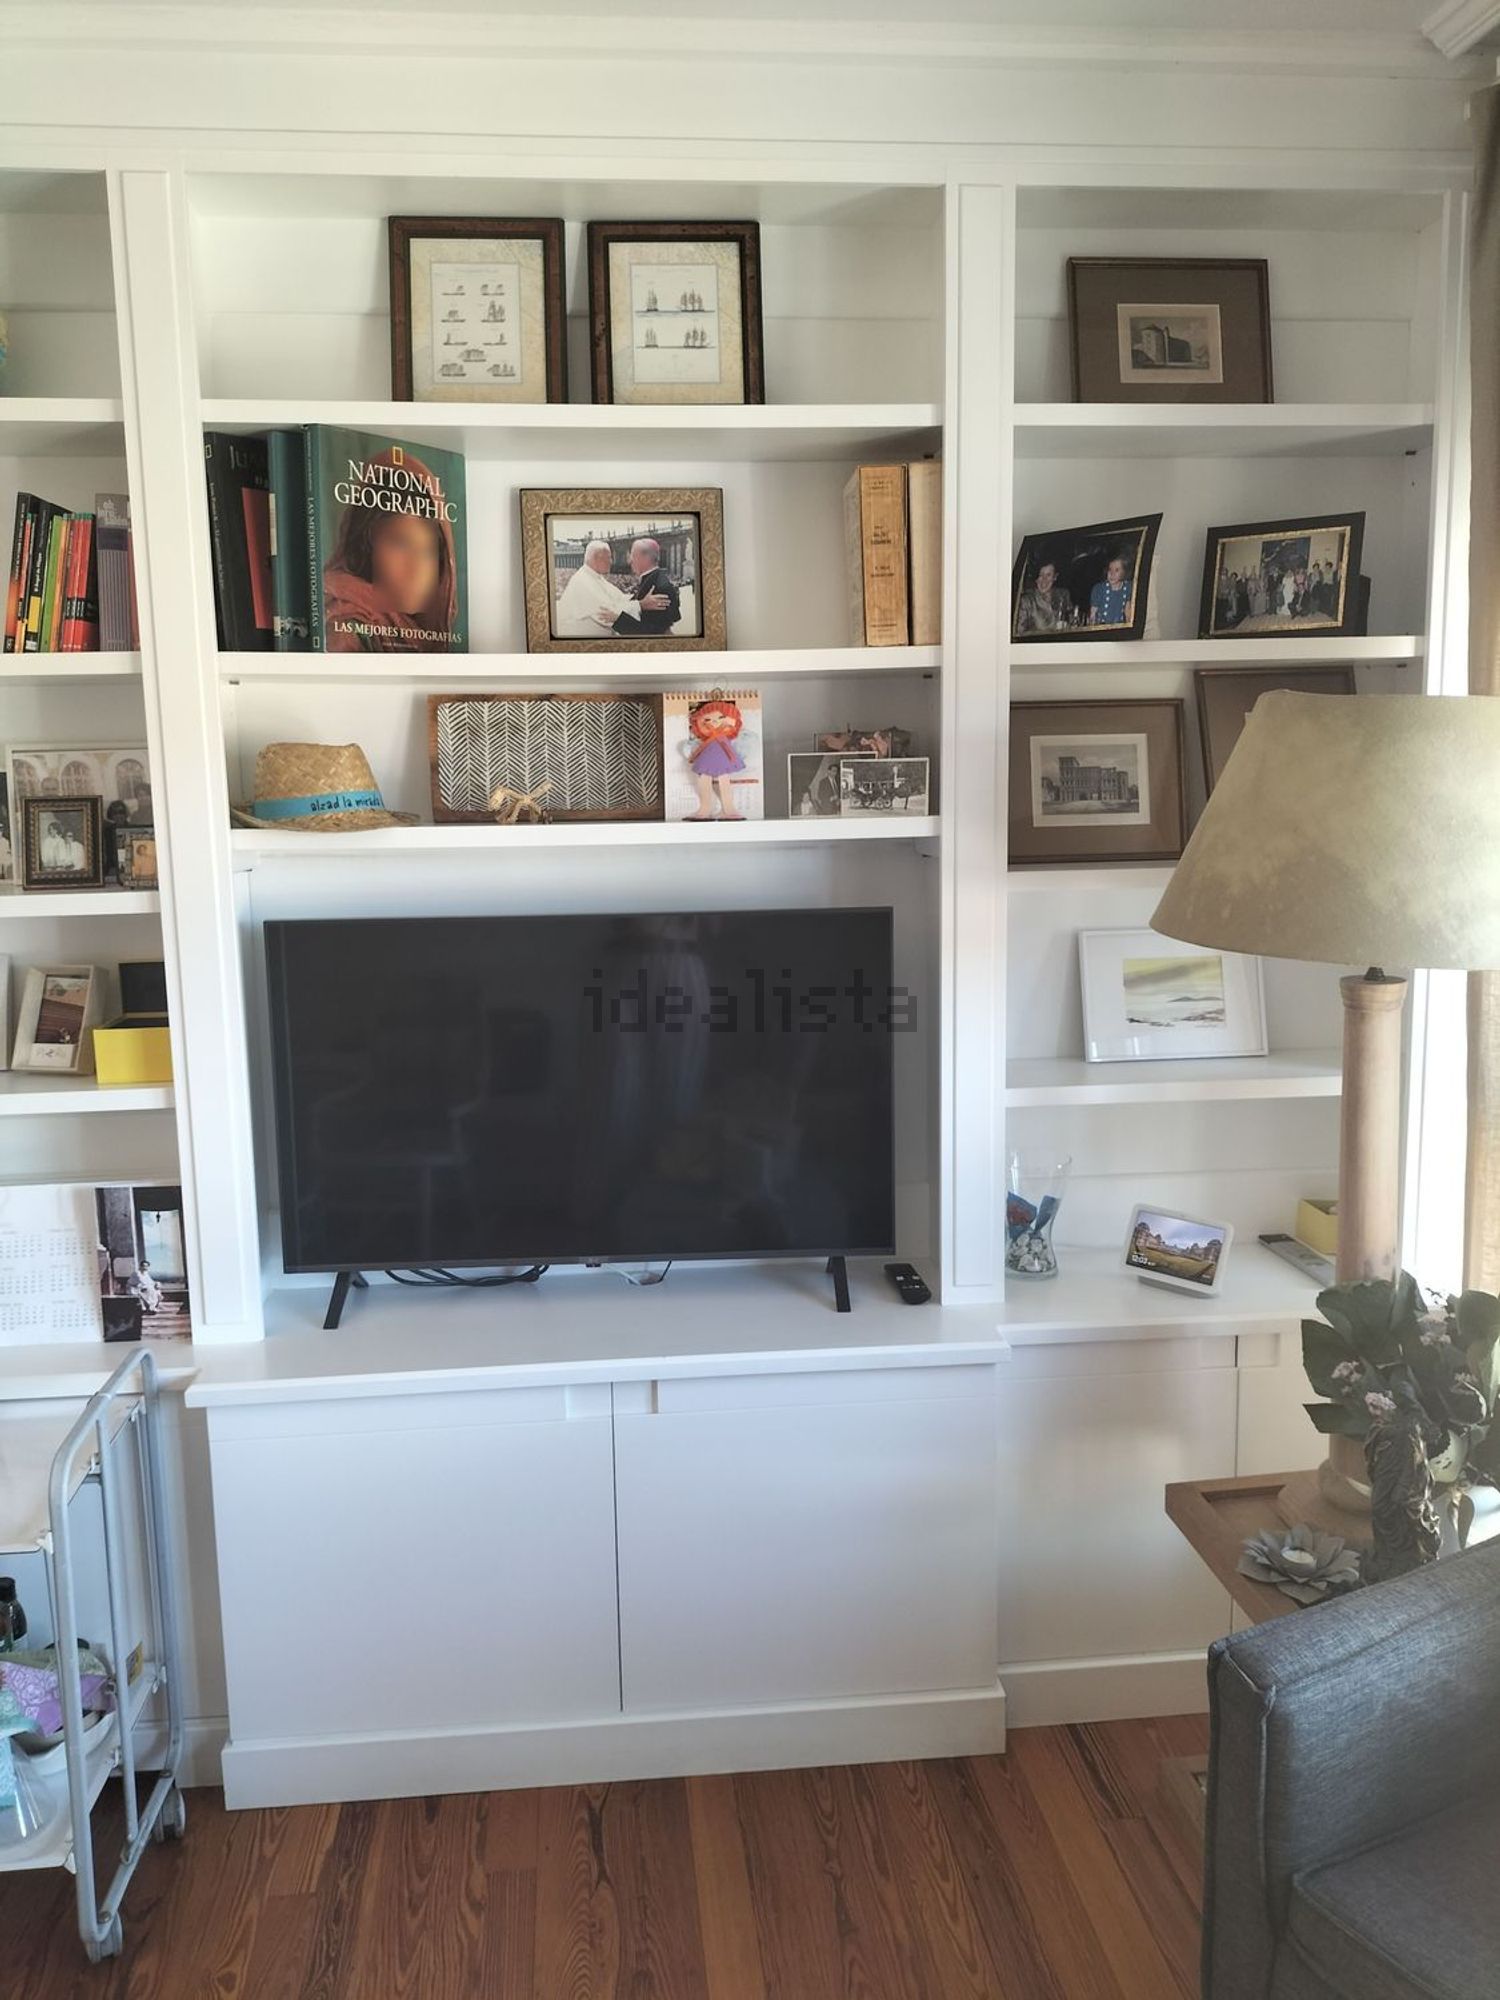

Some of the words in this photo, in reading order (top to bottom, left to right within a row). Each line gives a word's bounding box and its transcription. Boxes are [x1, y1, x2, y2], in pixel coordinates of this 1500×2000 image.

[348, 459, 445, 498] NATIONAL
[307, 497, 316, 514] LAS
[334, 482, 458, 522] GEOGRAPHIC
[308, 515, 318, 560] MEJORES
[334, 621, 353, 633] LAS
[355, 623, 399, 638] MEJORES
[310, 796, 340, 812] alzad
[343, 796, 352, 808] la
